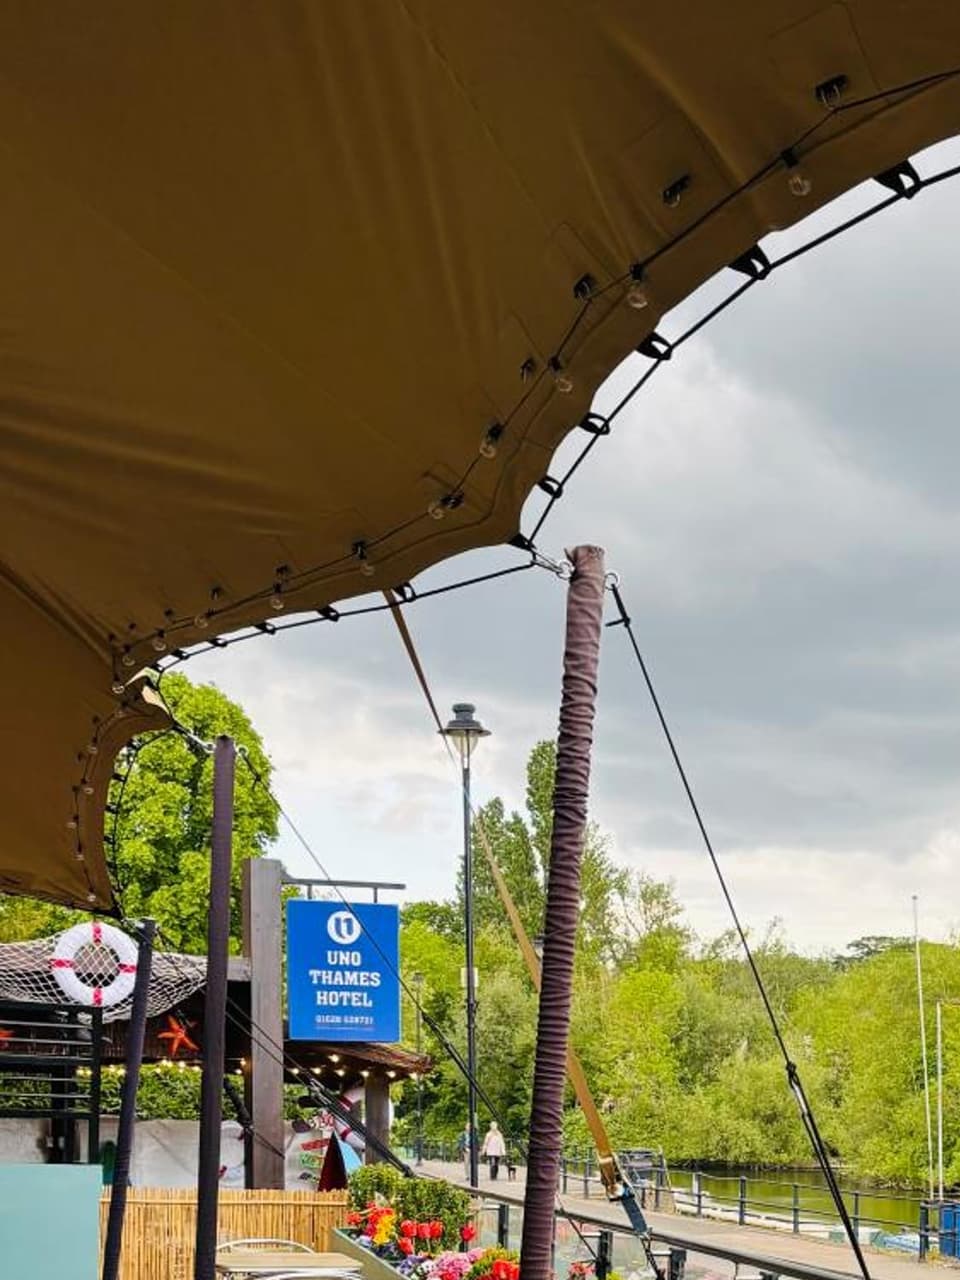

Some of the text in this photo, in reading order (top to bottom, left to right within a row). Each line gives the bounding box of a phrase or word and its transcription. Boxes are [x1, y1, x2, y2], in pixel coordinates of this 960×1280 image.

[326, 950, 362, 967] UNO
[308, 969, 382, 988] THAMES
[316, 990, 373, 1008] HOTEL
